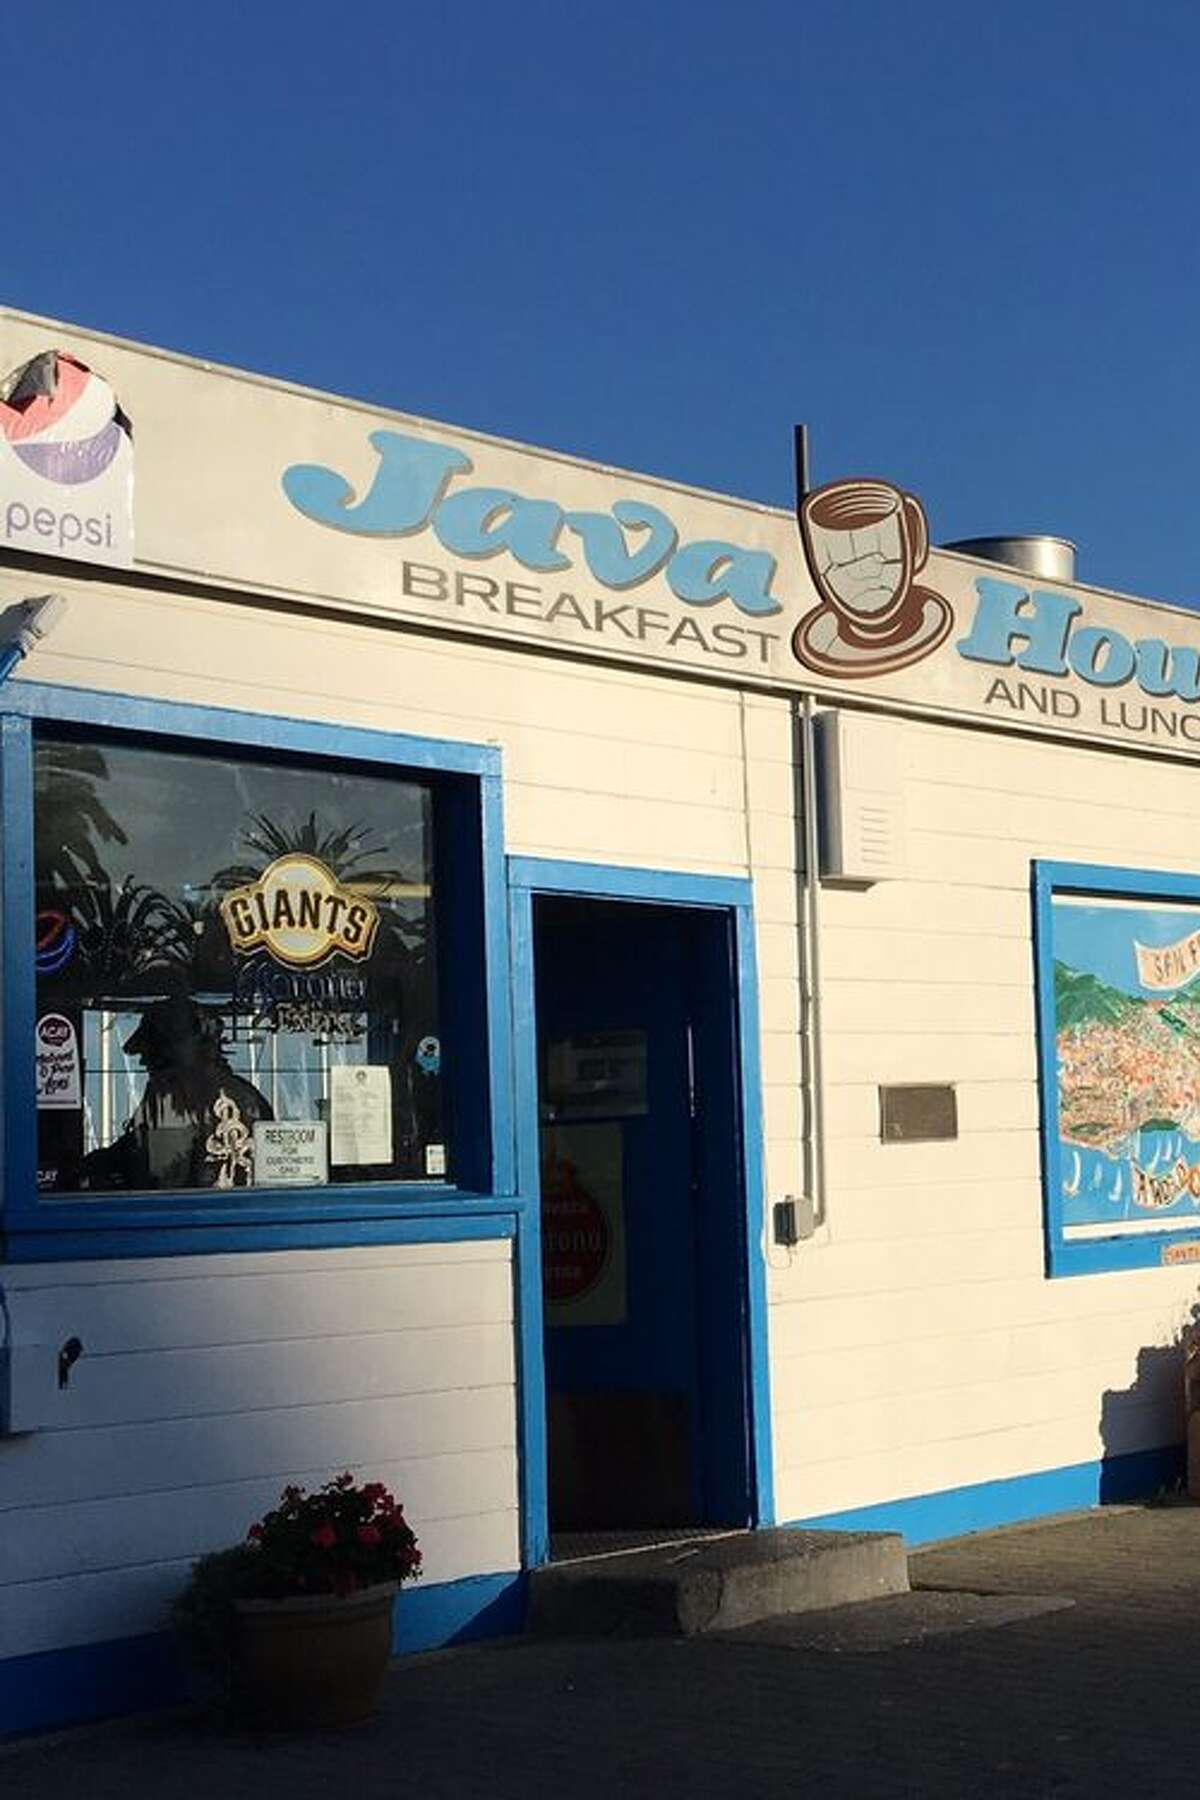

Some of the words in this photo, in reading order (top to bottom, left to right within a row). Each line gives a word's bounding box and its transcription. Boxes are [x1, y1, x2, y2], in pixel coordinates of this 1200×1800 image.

[6, 502, 111, 547] pepsi
[281, 430, 783, 616] Java
[402, 561, 779, 663] BREAKFAST
[984, 678, 1080, 718] AND
[230, 889, 368, 943] GIANTS
[1153, 946, 1187, 981] SAN
[265, 1129, 316, 1144] RESTROOM
